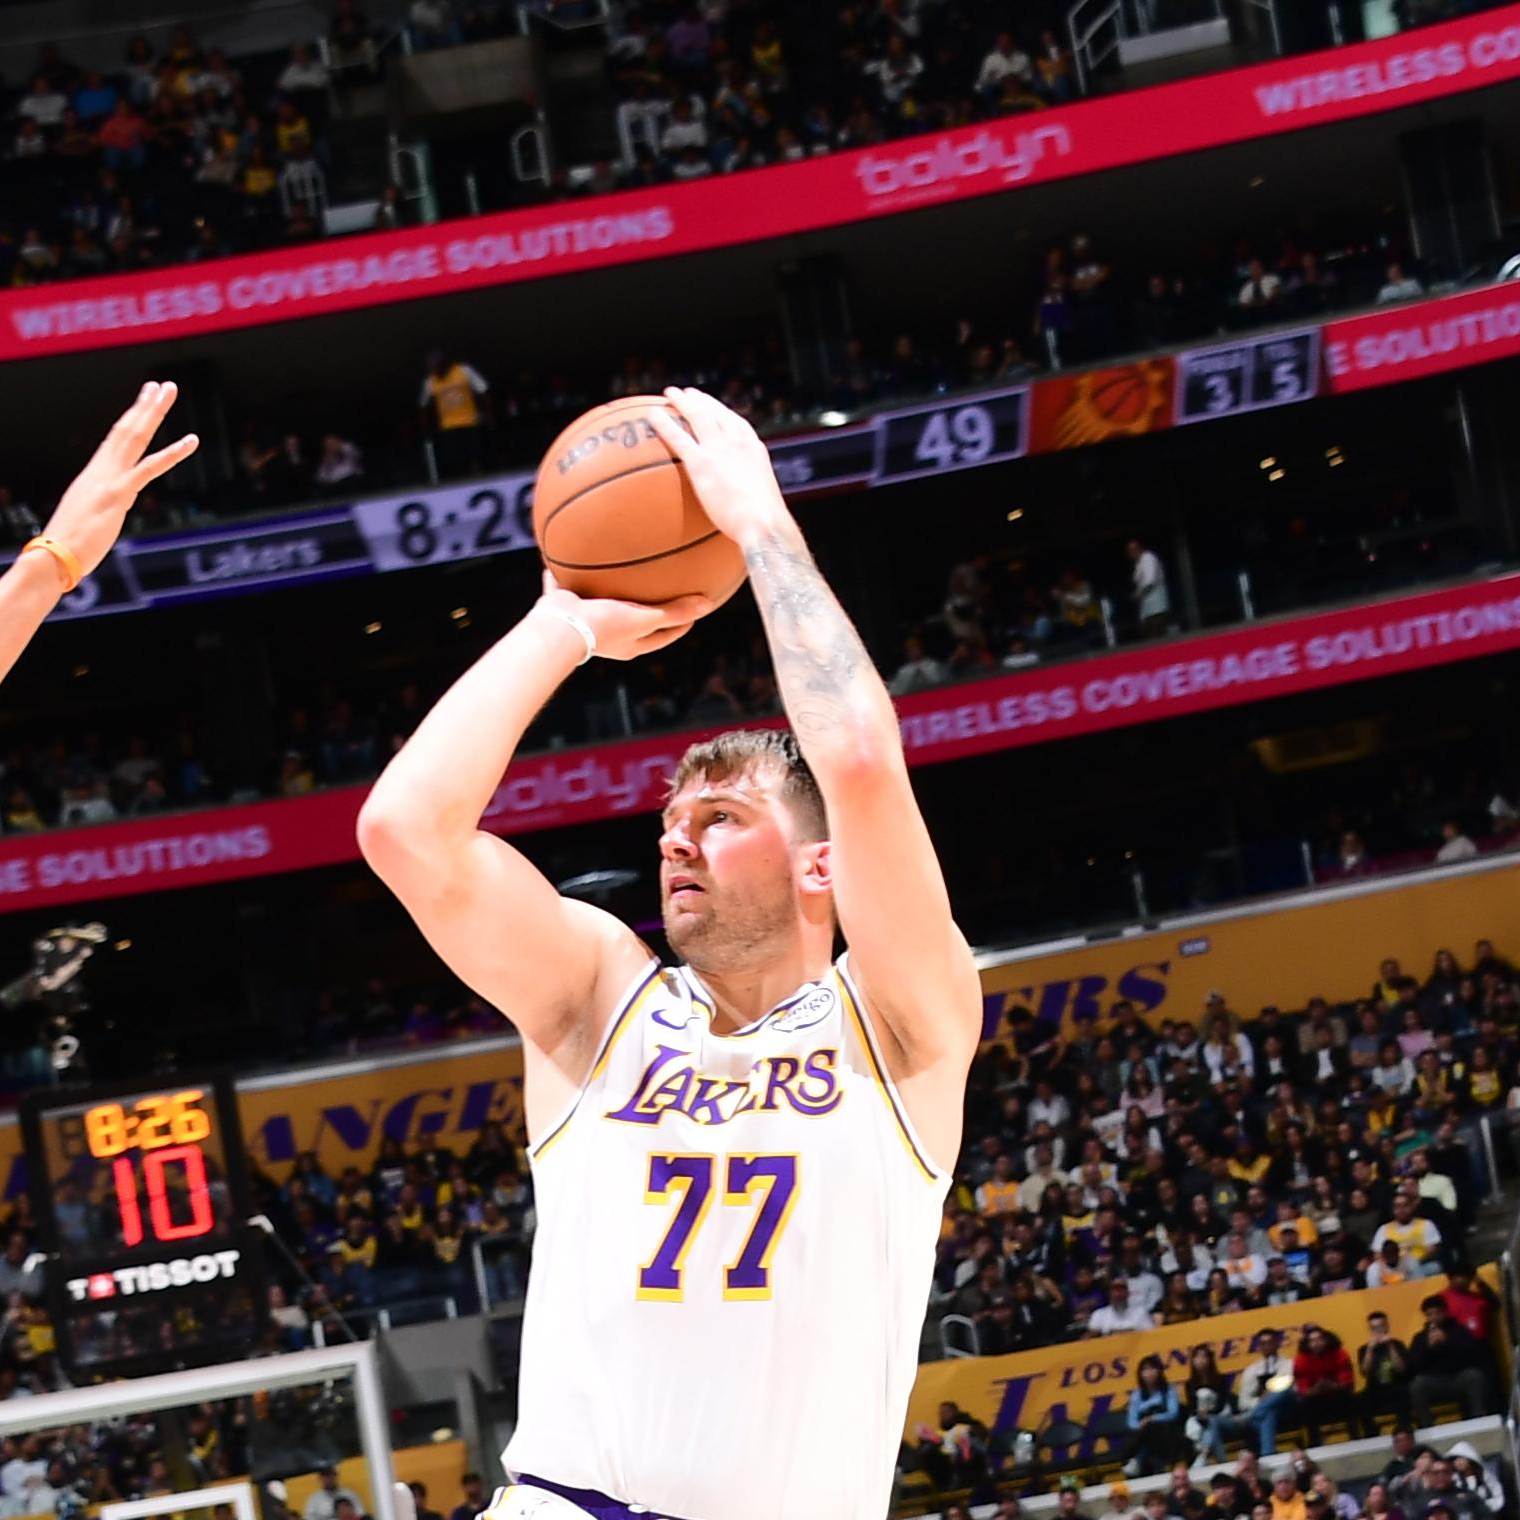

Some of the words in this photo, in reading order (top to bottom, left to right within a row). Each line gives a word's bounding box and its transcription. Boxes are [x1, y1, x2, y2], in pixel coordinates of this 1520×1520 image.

[1255, 42, 1465, 116] WIRELESS
[856, 122, 1070, 202] boldyn
[12, 279, 221, 340] WIRELESS
[226, 251, 439, 311] COVERAGE
[446, 206, 674, 274] SOLUTIONS
[914, 402, 996, 471] 49
[184, 537, 323, 585] Lakers
[1081, 643, 1300, 713] COVERAGE
[40, 822, 271, 890] SOLUTIONS
[601, 1041, 846, 1129] LAKERS
[84, 1088, 212, 1158] 8:26
[112, 1144, 214, 1248] 10
[634, 1150, 802, 1303] 77
[113, 1249, 241, 1297] TISSOT
[1059, 1355, 1128, 1389] LOS
